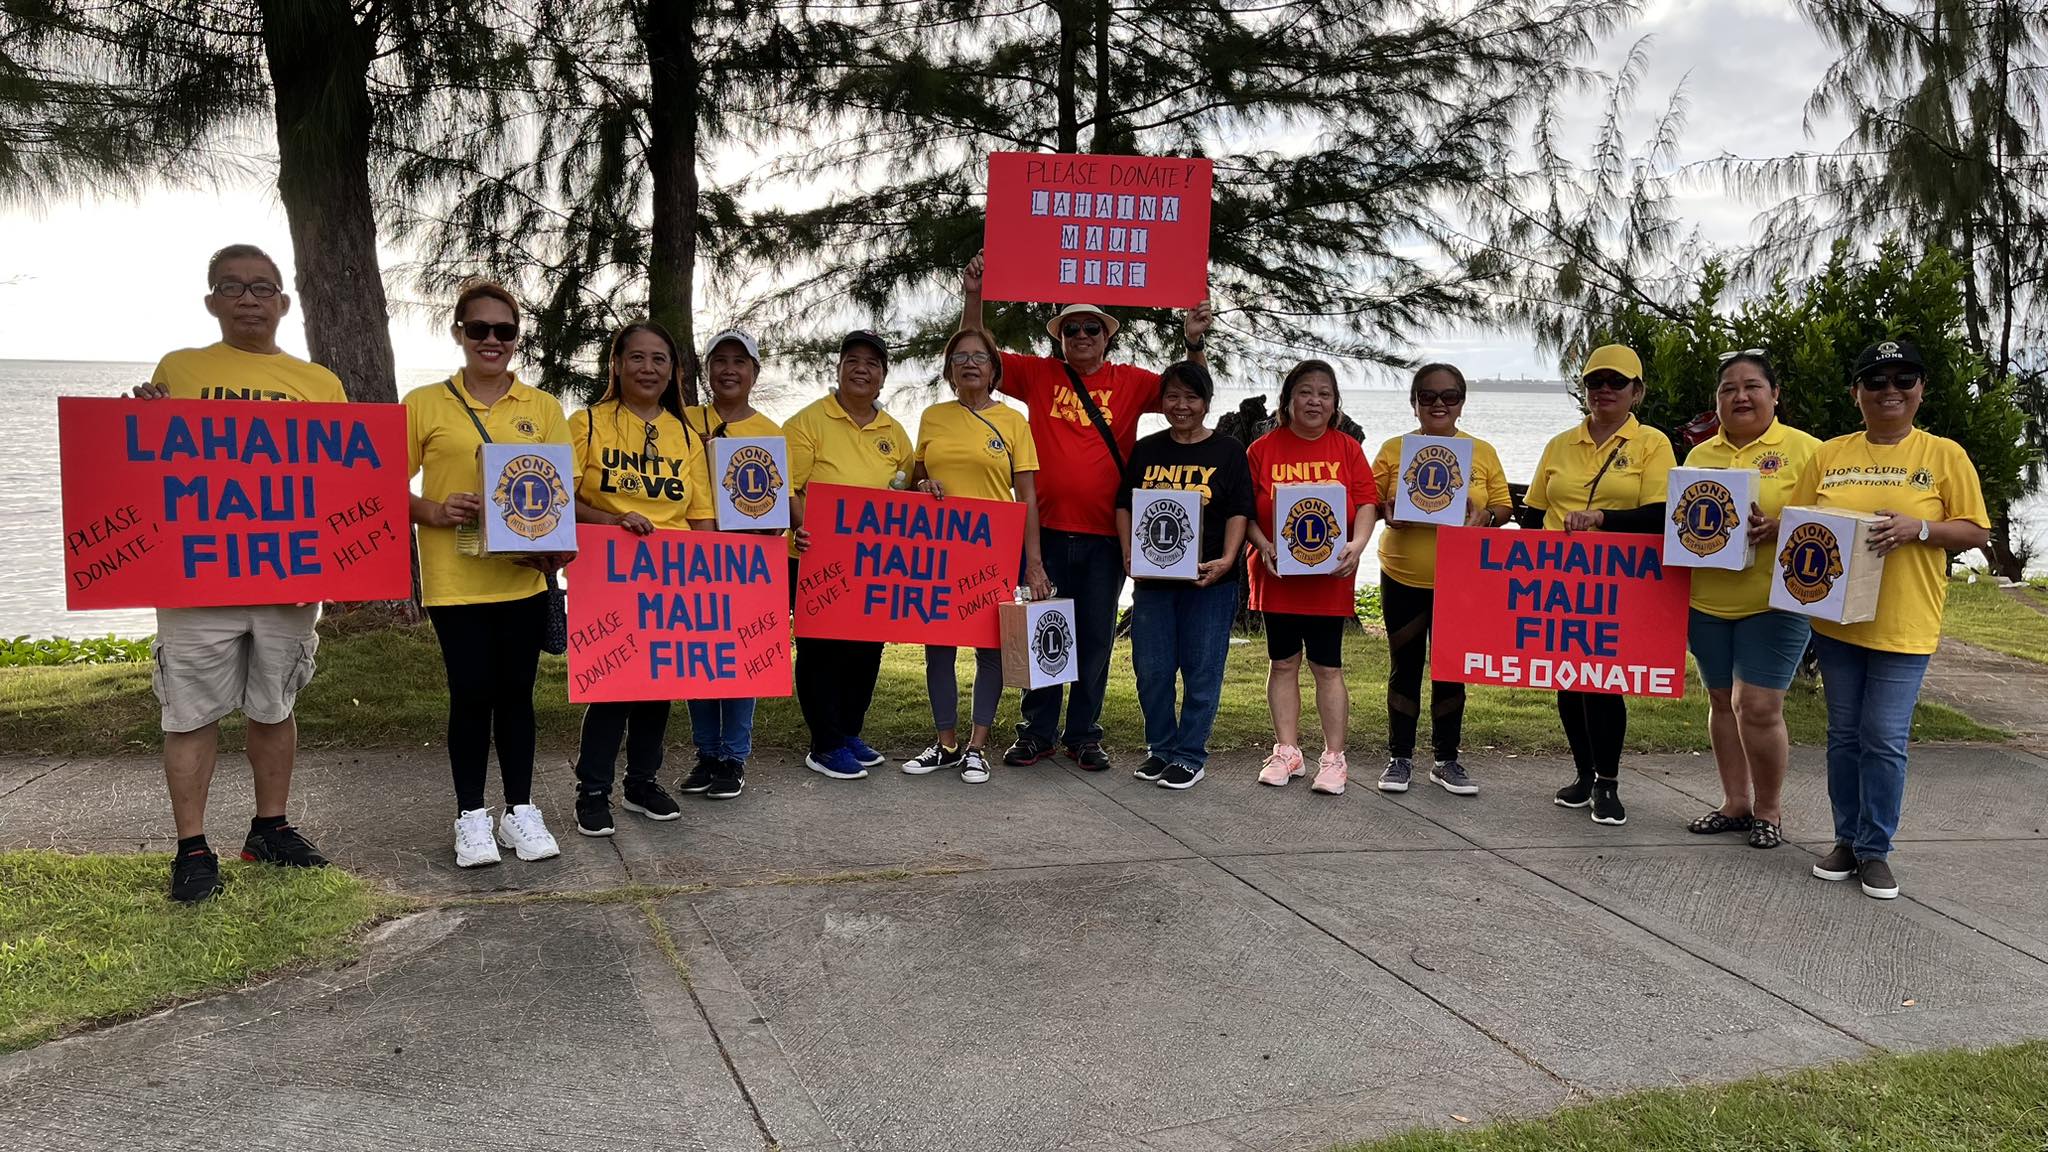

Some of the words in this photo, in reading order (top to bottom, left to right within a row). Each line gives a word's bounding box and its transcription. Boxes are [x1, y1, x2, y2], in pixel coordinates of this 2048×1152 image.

[1027, 159, 1098, 185] PLEASE
[1110, 162, 1196, 189] DONATE!
[1032, 191, 1179, 221] LAHAINA
[1062, 226, 1147, 252] MAUI
[1061, 259, 1146, 286] FIRE
[125, 415, 382, 469] LAHAINA
[733, 448, 769, 465] LIONS
[1419, 448, 1455, 466] LIONS
[507, 458, 552, 476] LIONS
[602, 446, 683, 478] UNITY
[1144, 465, 1217, 485] UNITY
[1271, 461, 1341, 481] UNITY
[1825, 466, 1861, 477] LIONS
[1864, 466, 1908, 475] CLUBS
[745, 468, 762, 493] L
[1425, 466, 1441, 491] L
[1687, 483, 1727, 500] LIONS
[1821, 479, 1904, 490] INTERNATIONAL
[163, 475, 316, 522] MAUI
[522, 481, 543, 510] L
[1149, 501, 1182, 516] LIONS
[1293, 500, 1328, 516] LIONS
[67, 504, 142, 556] PLEASE
[327, 495, 385, 535] PLEASE
[834, 498, 992, 548] LAHAINA
[1696, 504, 1714, 531] L
[332, 520, 397, 571] HELP!
[1158, 520, 1173, 544] L
[1304, 519, 1320, 543] L
[1796, 525, 1833, 546] LIONS
[181, 530, 323, 581] FIRE
[606, 539, 772, 587] LAHAINA
[854, 541, 948, 581] MAUI
[1479, 538, 1664, 581] LAHAINA
[1801, 547, 1818, 577] L
[799, 560, 845, 596] PLEASE
[958, 563, 1001, 595] PLEASE
[863, 583, 952, 625] FIRE
[1507, 577, 1619, 616] MAUI
[637, 592, 732, 632] MAUI
[1039, 613, 1065, 629] LIONS
[569, 610, 624, 654] PLEASE
[737, 610, 778, 649] PLEASE
[1047, 631, 1060, 654] L
[1515, 616, 1620, 657] FIRE
[575, 632, 639, 694] DONATE!
[649, 640, 736, 682] FIRE
[744, 641, 784, 680] HELP!
[1463, 651, 1521, 683] PLS
[1529, 658, 1676, 695] DONATE
